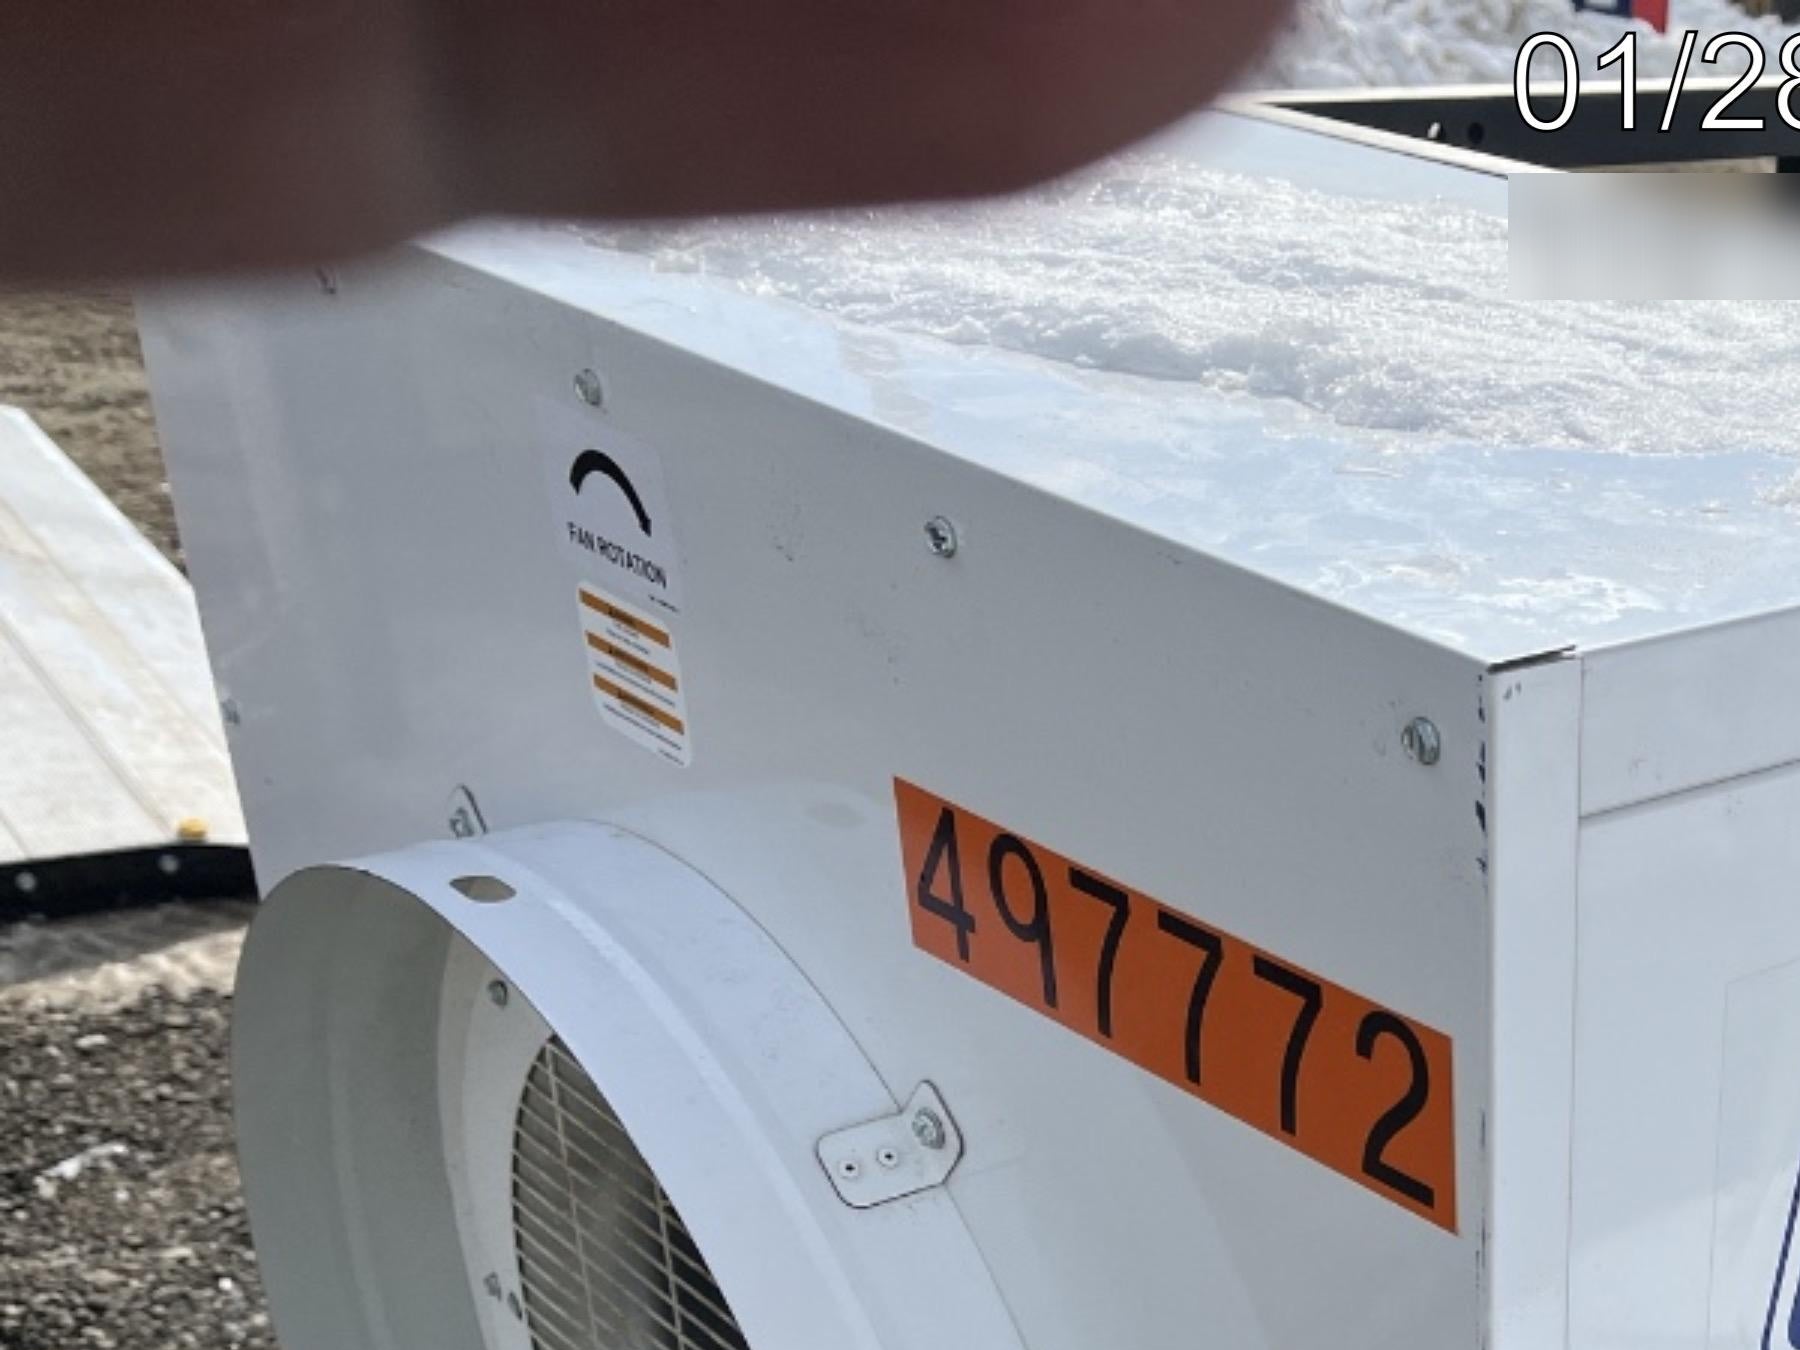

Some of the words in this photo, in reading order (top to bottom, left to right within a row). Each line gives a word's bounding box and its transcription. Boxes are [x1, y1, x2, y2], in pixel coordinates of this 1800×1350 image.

[567, 521, 595, 553] FAN
[596, 536, 667, 590] ROTATION
[917, 806, 1434, 1210] 497772
